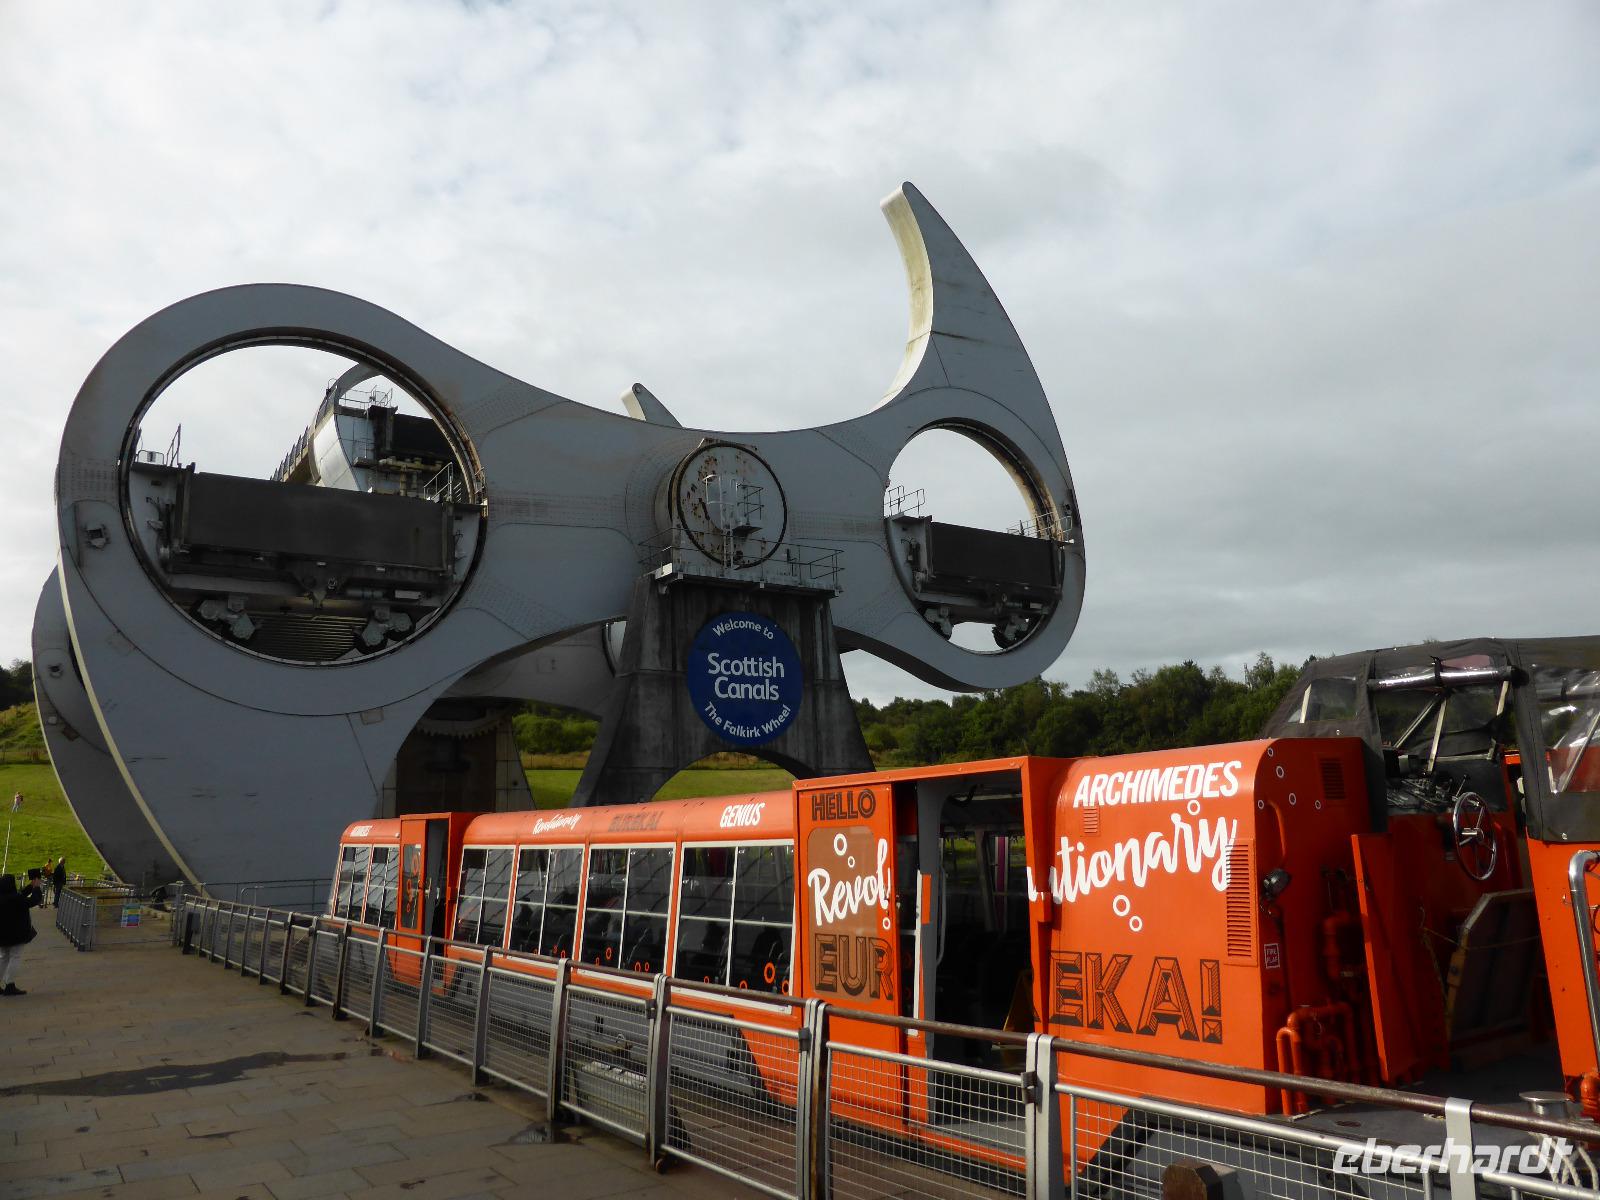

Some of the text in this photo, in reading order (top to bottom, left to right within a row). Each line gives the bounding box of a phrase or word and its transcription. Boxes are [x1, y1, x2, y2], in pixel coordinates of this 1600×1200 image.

[712, 618, 774, 640] Welcome to
[707, 652, 785, 678] Scottish
[714, 676, 780, 701] Canals
[704, 701, 791, 738] The Falkirk Wheel
[1073, 760, 1242, 809] ARCHIMEDES
[719, 802, 766, 828] GENIUS
[811, 788, 877, 822] HELLO
[814, 932, 894, 1001] EUR
[1048, 950, 1223, 1045] EKA!
